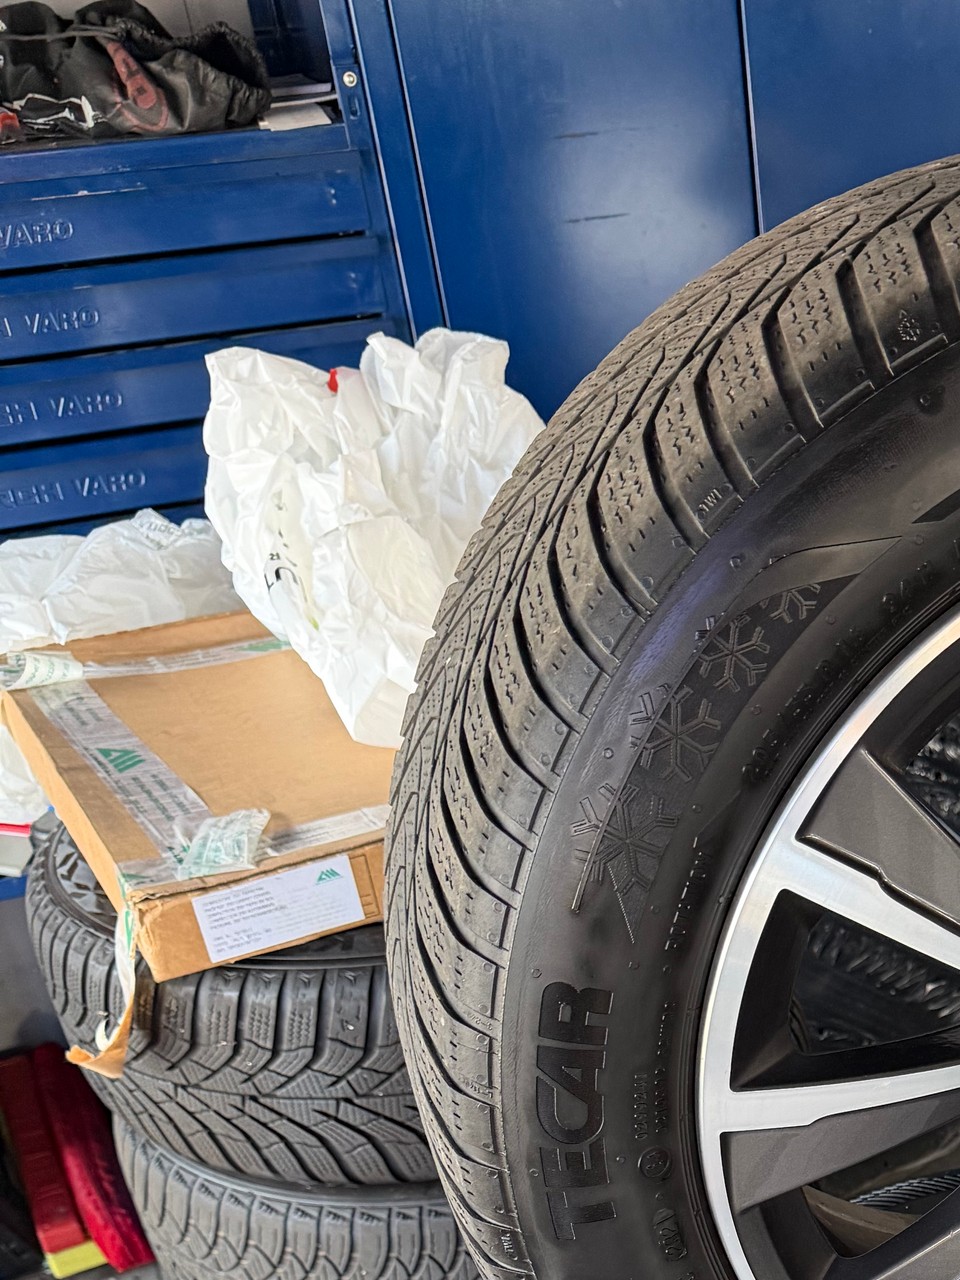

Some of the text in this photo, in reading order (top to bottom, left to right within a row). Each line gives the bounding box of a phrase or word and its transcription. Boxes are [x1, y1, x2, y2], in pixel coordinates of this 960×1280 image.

[25, 305, 100, 334] VARO
[50, 391, 123, 418] VARO
[72, 471, 146, 497] VARO
[535, 981, 614, 1241] TECAR
